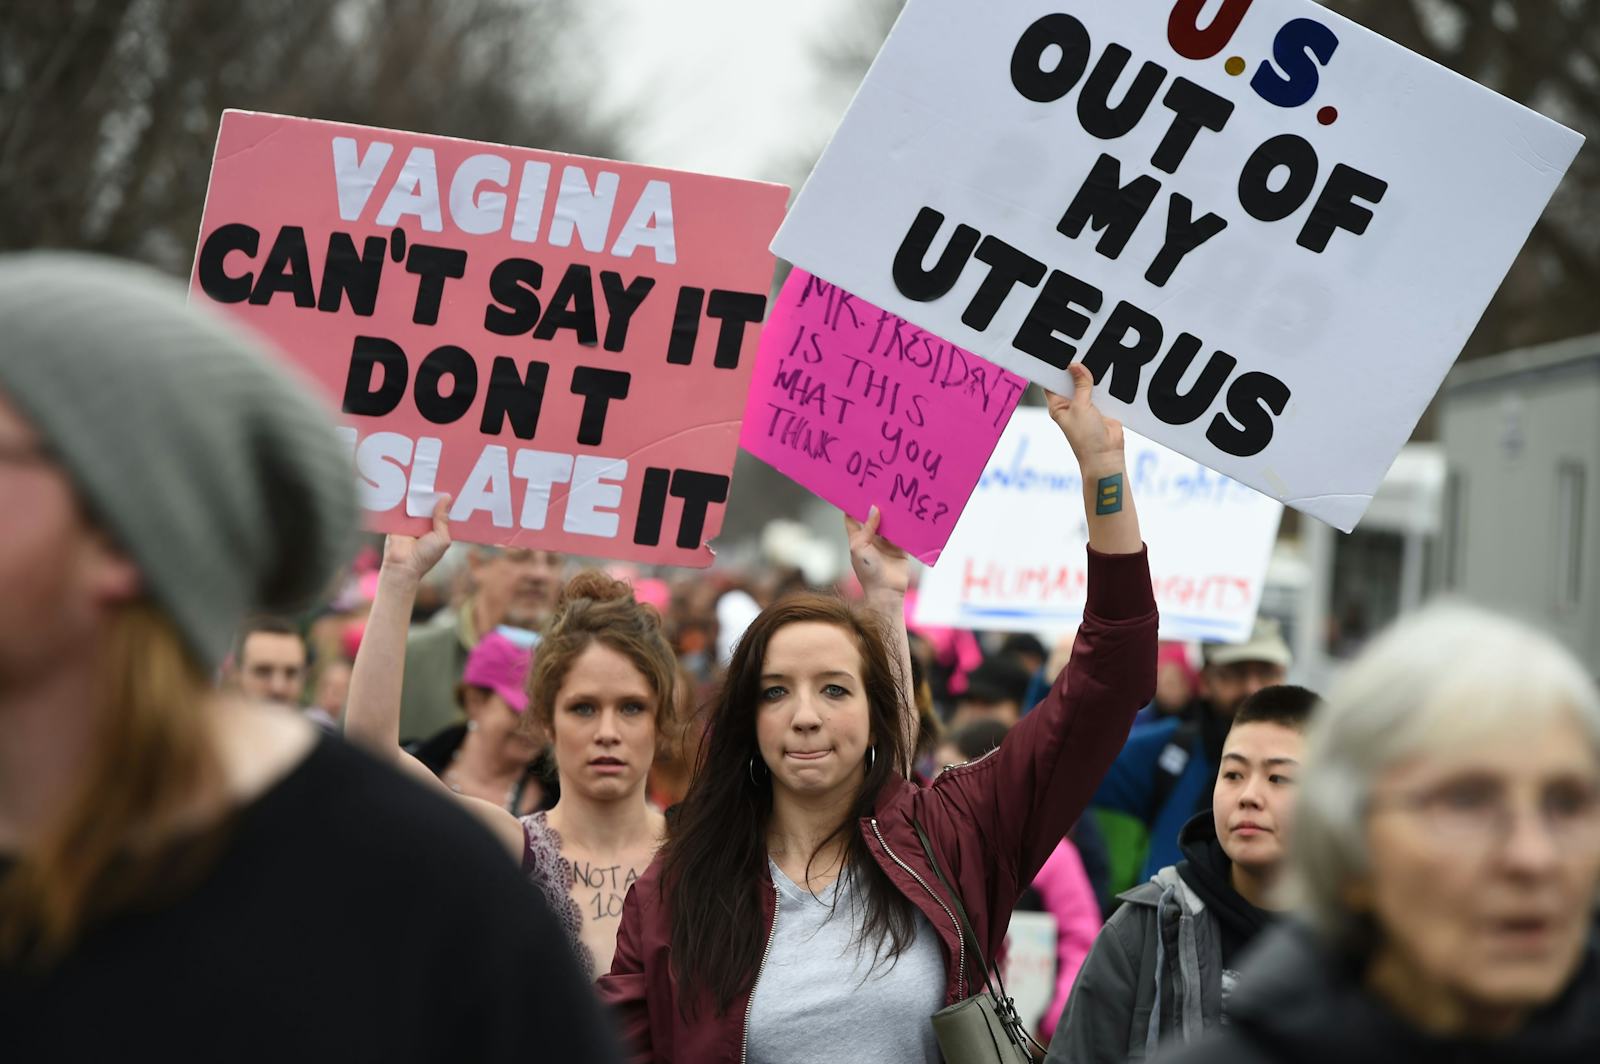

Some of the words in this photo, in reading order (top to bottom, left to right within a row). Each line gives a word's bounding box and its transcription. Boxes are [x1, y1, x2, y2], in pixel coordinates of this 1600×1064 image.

[1167, 0, 1338, 125] U.S.
[1010, 12, 1235, 175] OUT
[1238, 133, 1389, 254] OF
[332, 136, 678, 264] VAGINA
[1056, 152, 1228, 288] MY
[198, 222, 469, 326] CAN'T
[483, 257, 656, 353] SAY
[666, 286, 767, 370] IT
[797, 273, 865, 331] MR.
[892, 205, 1292, 458] UTERUS
[772, 359, 855, 425] WHAT
[788, 325, 823, 364] IS
[842, 353, 928, 427] THIS
[335, 426, 629, 538] SLATE
[633, 466, 731, 550] IT
[767, 402, 840, 464] THINK
[846, 451, 885, 488] OF
[889, 473, 949, 525] ME?
[573, 861, 621, 890] NOT
[624, 867, 640, 891] A
